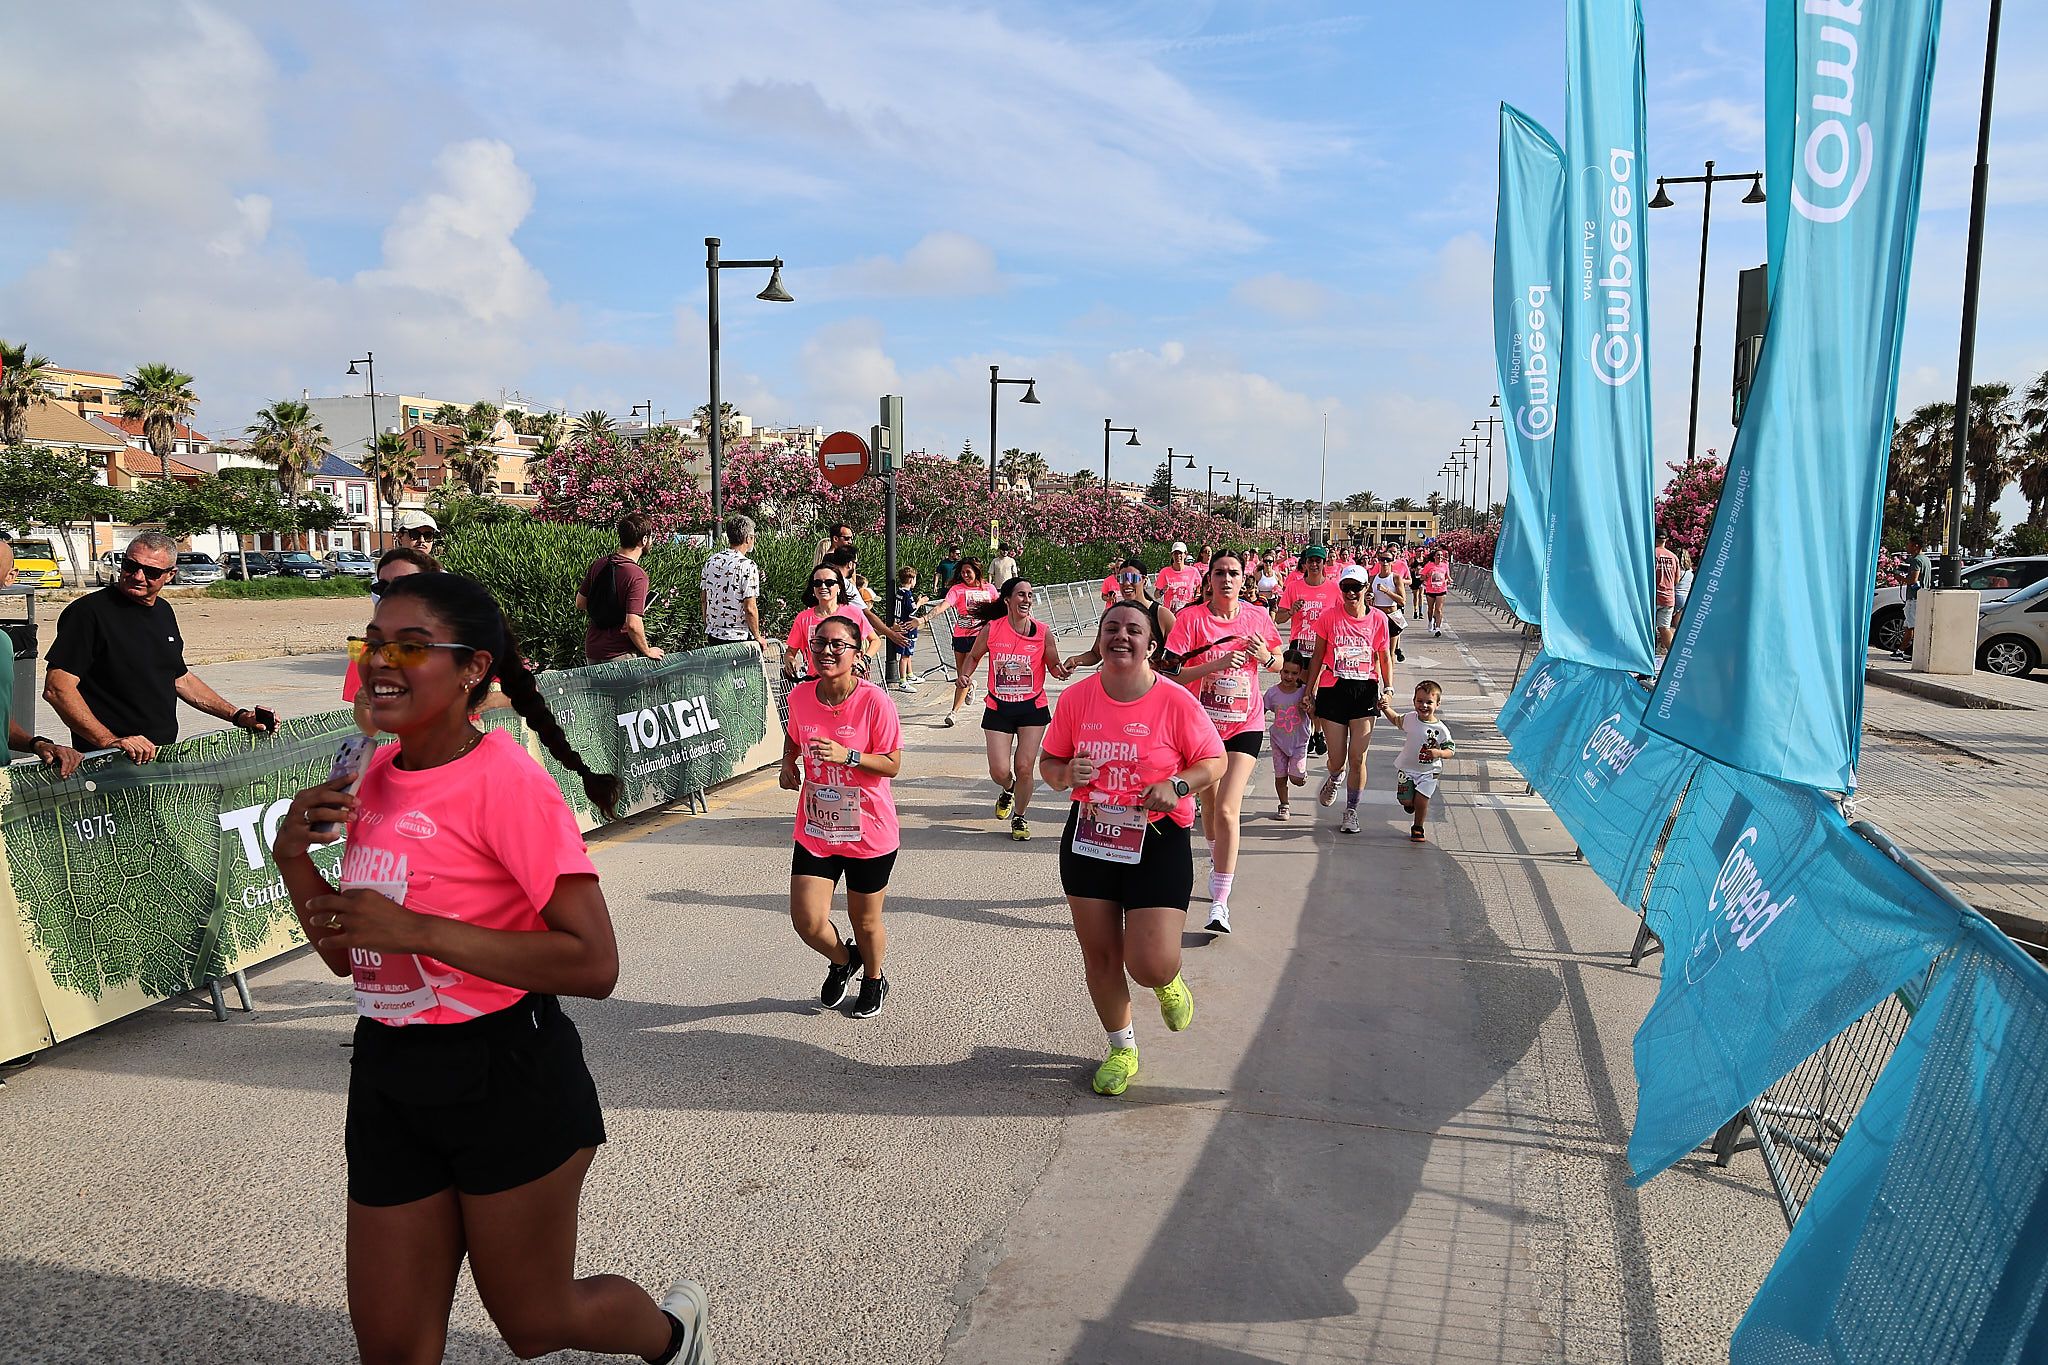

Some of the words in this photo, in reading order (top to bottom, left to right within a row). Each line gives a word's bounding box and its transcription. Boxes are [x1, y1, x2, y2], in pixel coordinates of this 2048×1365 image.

[1215, 695, 1234, 704] 016
[557, 709, 576, 725] 1975
[1078, 741, 1138, 762] CARRERA
[1582, 713, 1649, 776] Compeed
[630, 754, 670, 777] Cuidando
[671, 750, 682, 764] de
[682, 746, 689, 761] ti
[689, 741, 710, 758] desde
[711, 738, 726, 753] 1975
[818, 810, 839, 820] 016
[73, 814, 116, 841] 1975
[1095, 823, 1121, 837] 016
[1709, 827, 1797, 951] Compeed
[380, 1000, 415, 1010] Santander
